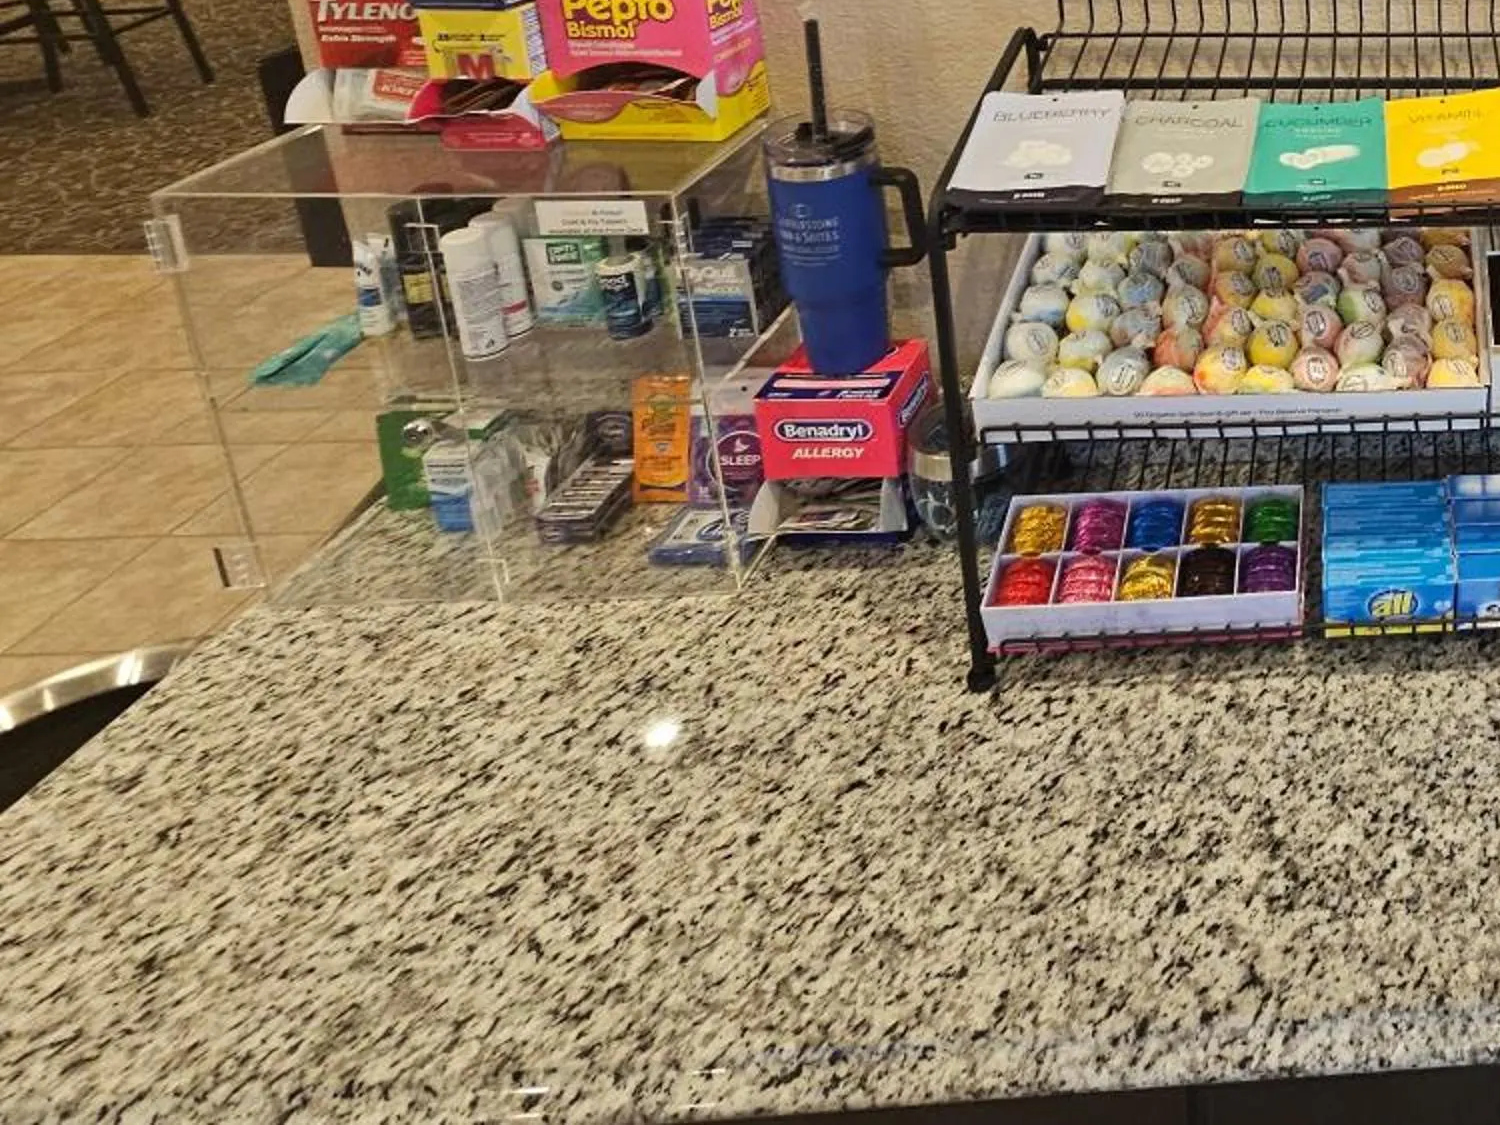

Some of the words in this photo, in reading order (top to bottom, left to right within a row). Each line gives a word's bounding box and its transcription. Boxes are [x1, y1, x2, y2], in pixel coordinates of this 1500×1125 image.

[567, 22, 636, 39] Bismol
[1134, 115, 1245, 128] CHARCOAL
[784, 424, 863, 442] Benadryl
[719, 454, 761, 466] SLEEP
[792, 447, 864, 460] ALLERGY
[1371, 591, 1414, 617] all
